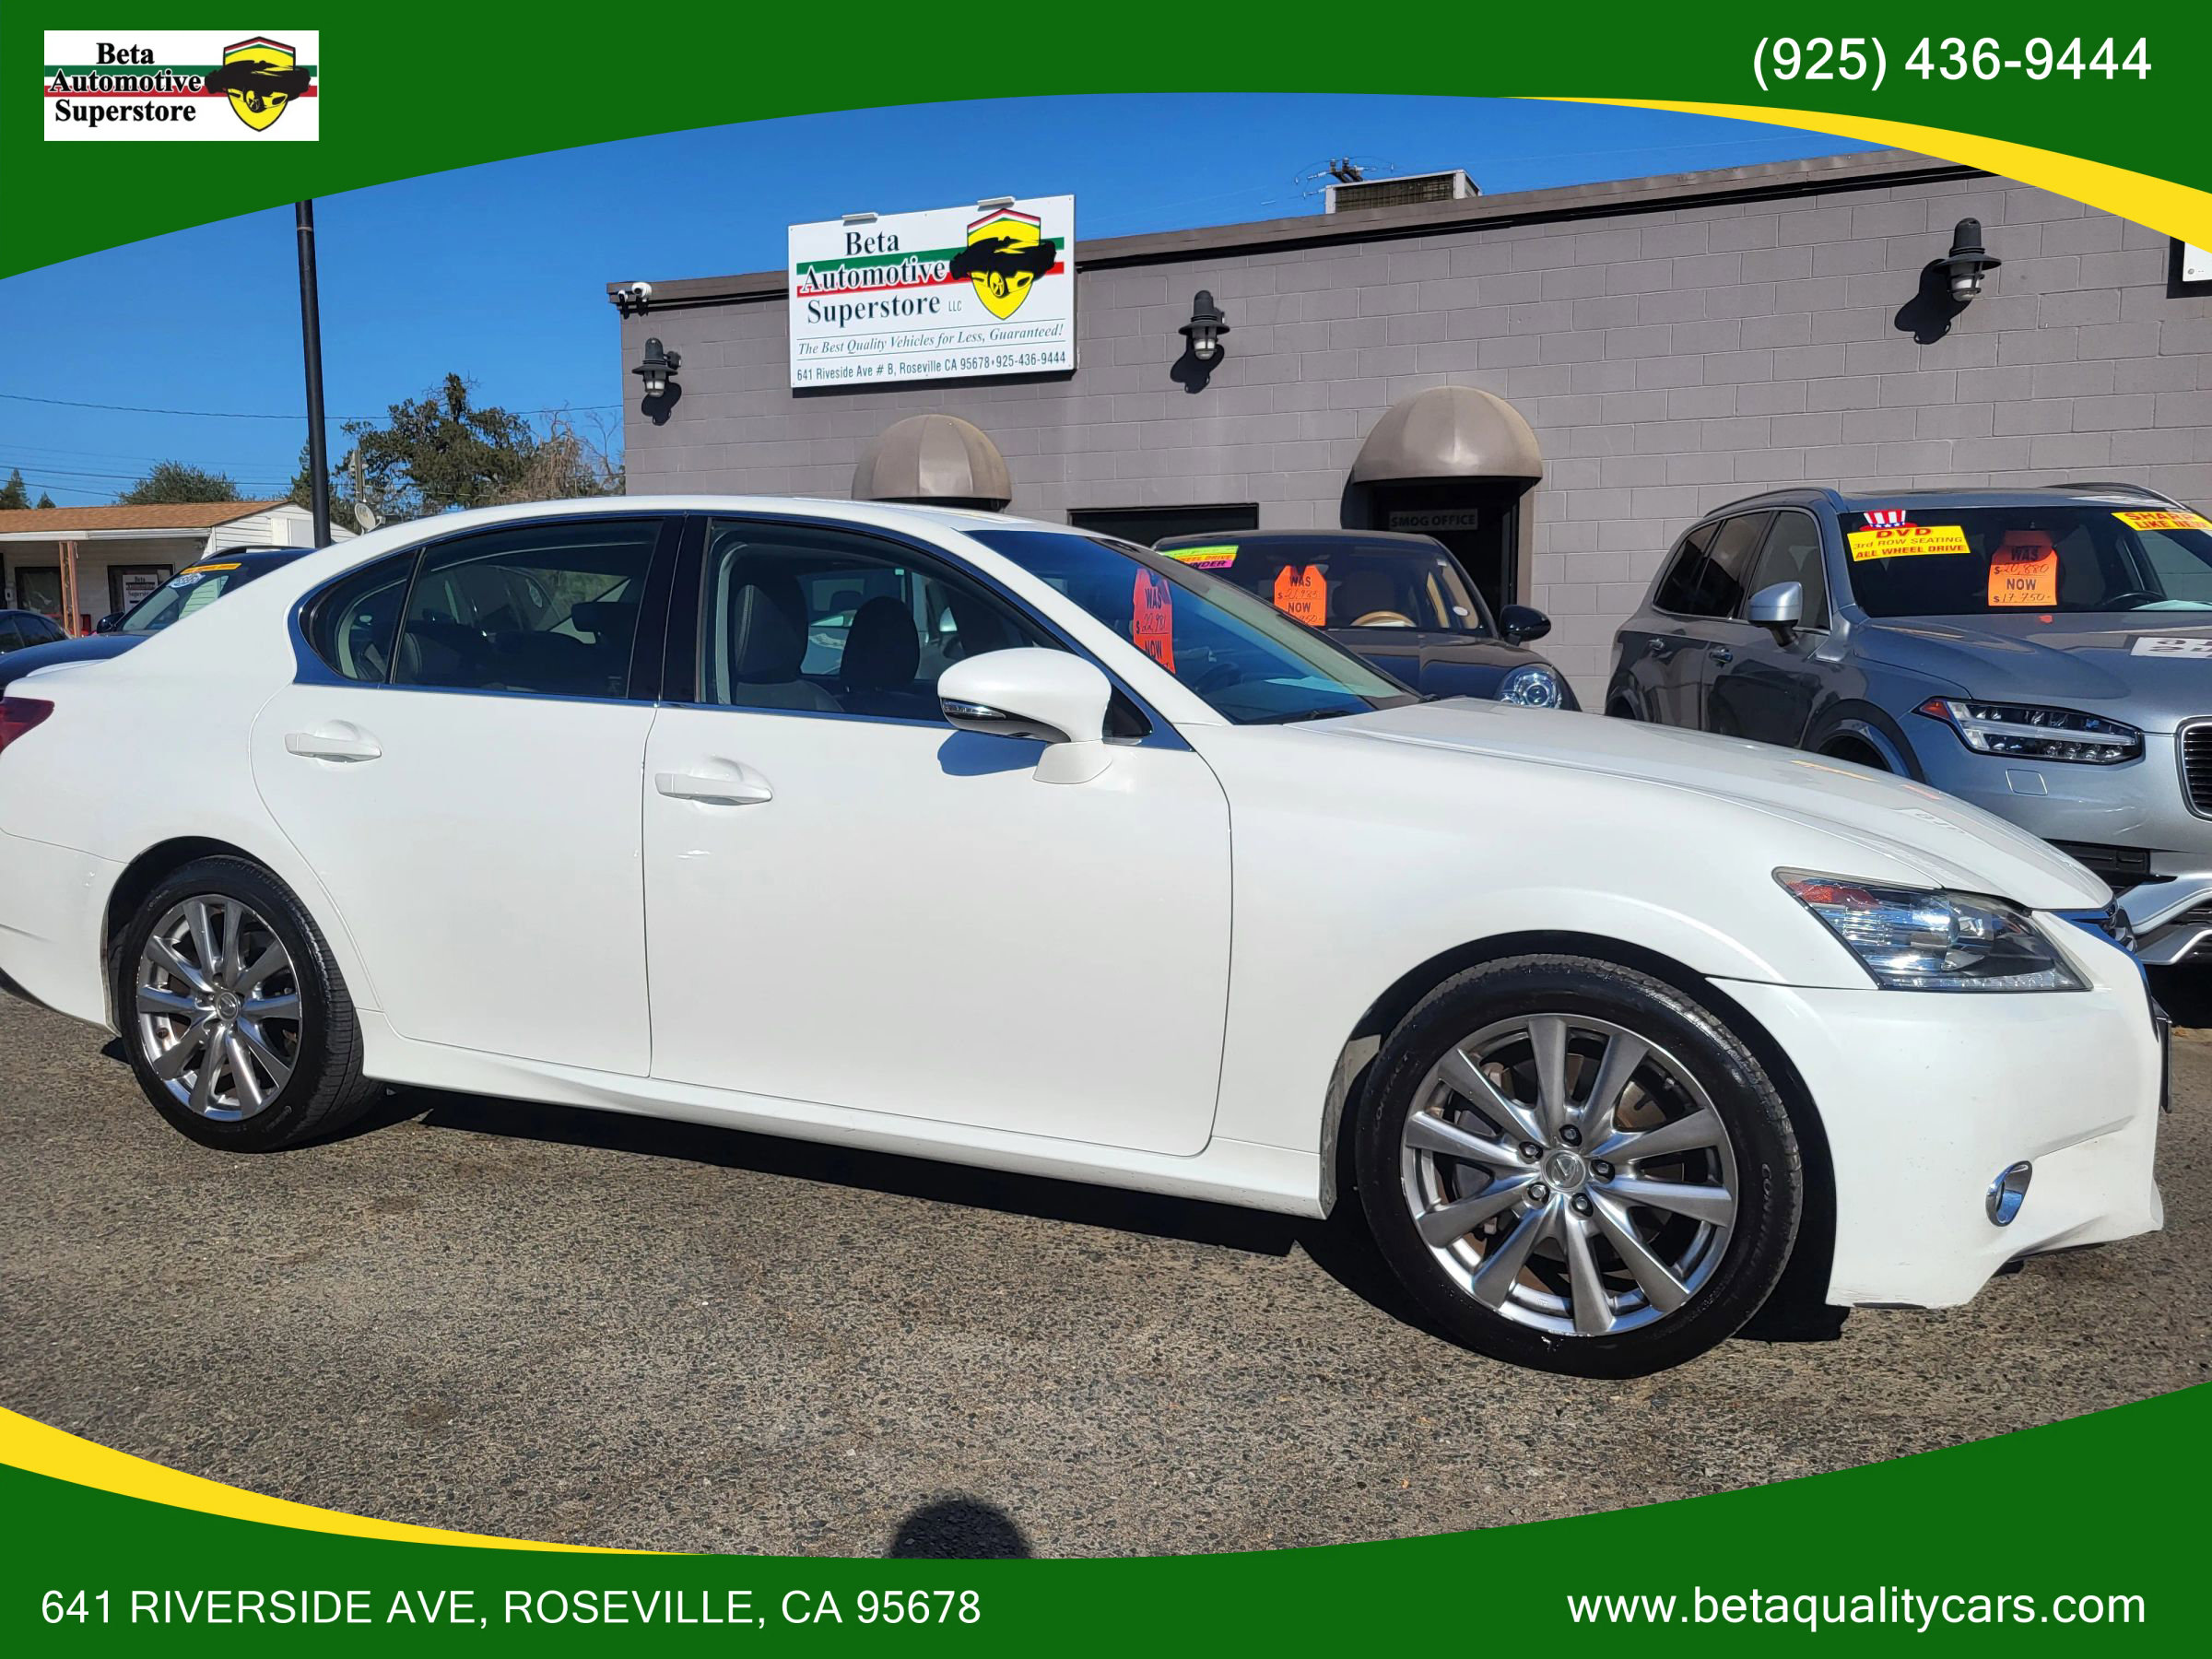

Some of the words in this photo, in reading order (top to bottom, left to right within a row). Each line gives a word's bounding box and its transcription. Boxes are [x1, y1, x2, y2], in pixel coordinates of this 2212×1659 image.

[845, 230, 900, 256] Beta
[801, 256, 946, 293] Automotive
[807, 294, 941, 328] Superstore
[948, 300, 962, 312] LLC
[798, 343, 818, 355] The
[821, 340, 844, 353] Best
[847, 337, 887, 352] Quality
[891, 335, 935, 348] Vehicles
[935, 332, 955, 347] for
[958, 331, 985, 345] Less,
[989, 324, 1064, 341] Guaranteed!
[797, 370, 813, 381] 641
[817, 366, 853, 379] Riveside
[856, 365, 873, 377] Ave
[876, 364, 883, 375] #
[888, 363, 897, 376] B,
[900, 359, 941, 374] Roseville
[945, 359, 957, 371] CA
[960, 356, 989, 370] 95678
[995, 351, 1065, 367] 925-436-9444
[1390, 516, 1430, 527] SMOG
[1431, 514, 1476, 525] OFFICE
[2124, 512, 2194, 521] SHARP
[1876, 527, 1932, 538] DVD
[1855, 550, 1877, 559] ALL
[1882, 547, 1924, 555] WHEEL
[2011, 546, 2039, 560] WAS
[1289, 576, 1312, 587] WAS
[2006, 579, 2036, 590] NOW
[1144, 587, 1162, 609] WAS
[1288, 602, 1312, 613] NOW
[1144, 640, 1163, 660] NOW
